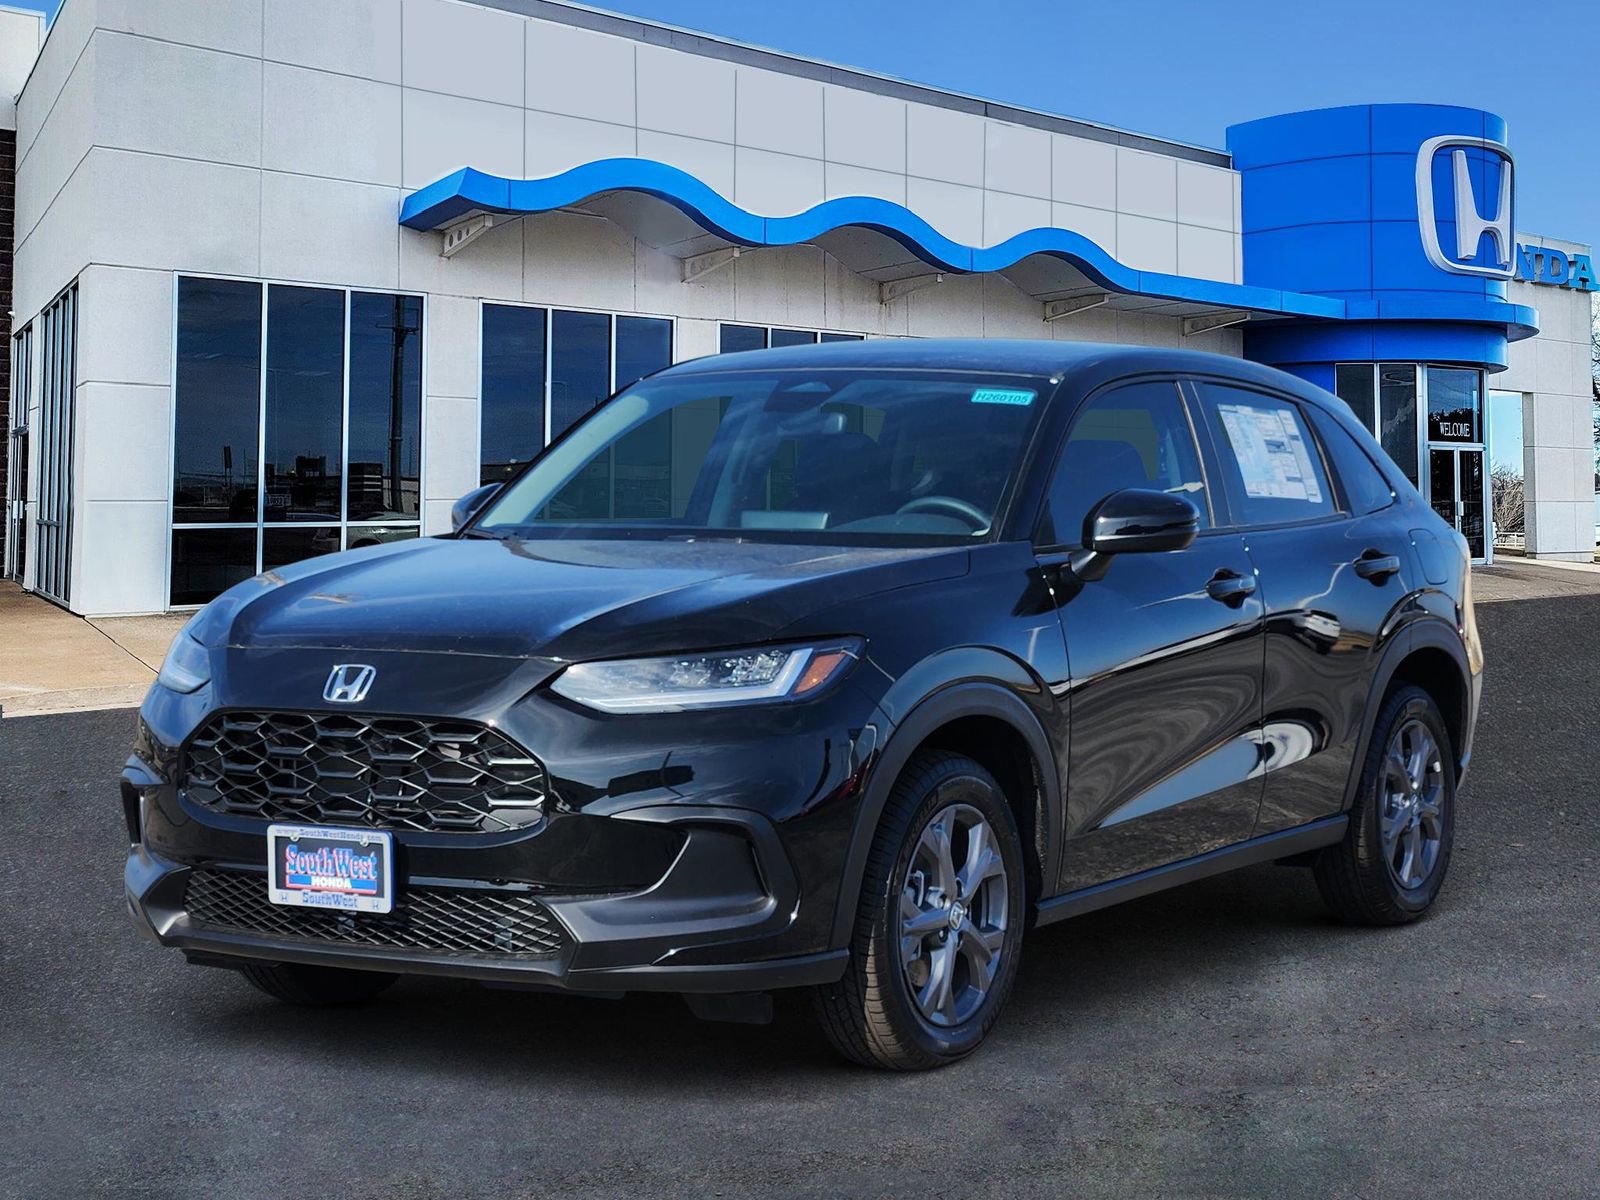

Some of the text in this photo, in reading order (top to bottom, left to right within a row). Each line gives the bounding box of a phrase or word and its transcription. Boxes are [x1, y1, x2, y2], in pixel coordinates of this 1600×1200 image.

[1439, 422, 1471, 438] WELCOME
[285, 844, 378, 880] SouthWest
[311, 876, 352, 890] HONDA
[302, 891, 358, 908] SouthWest
